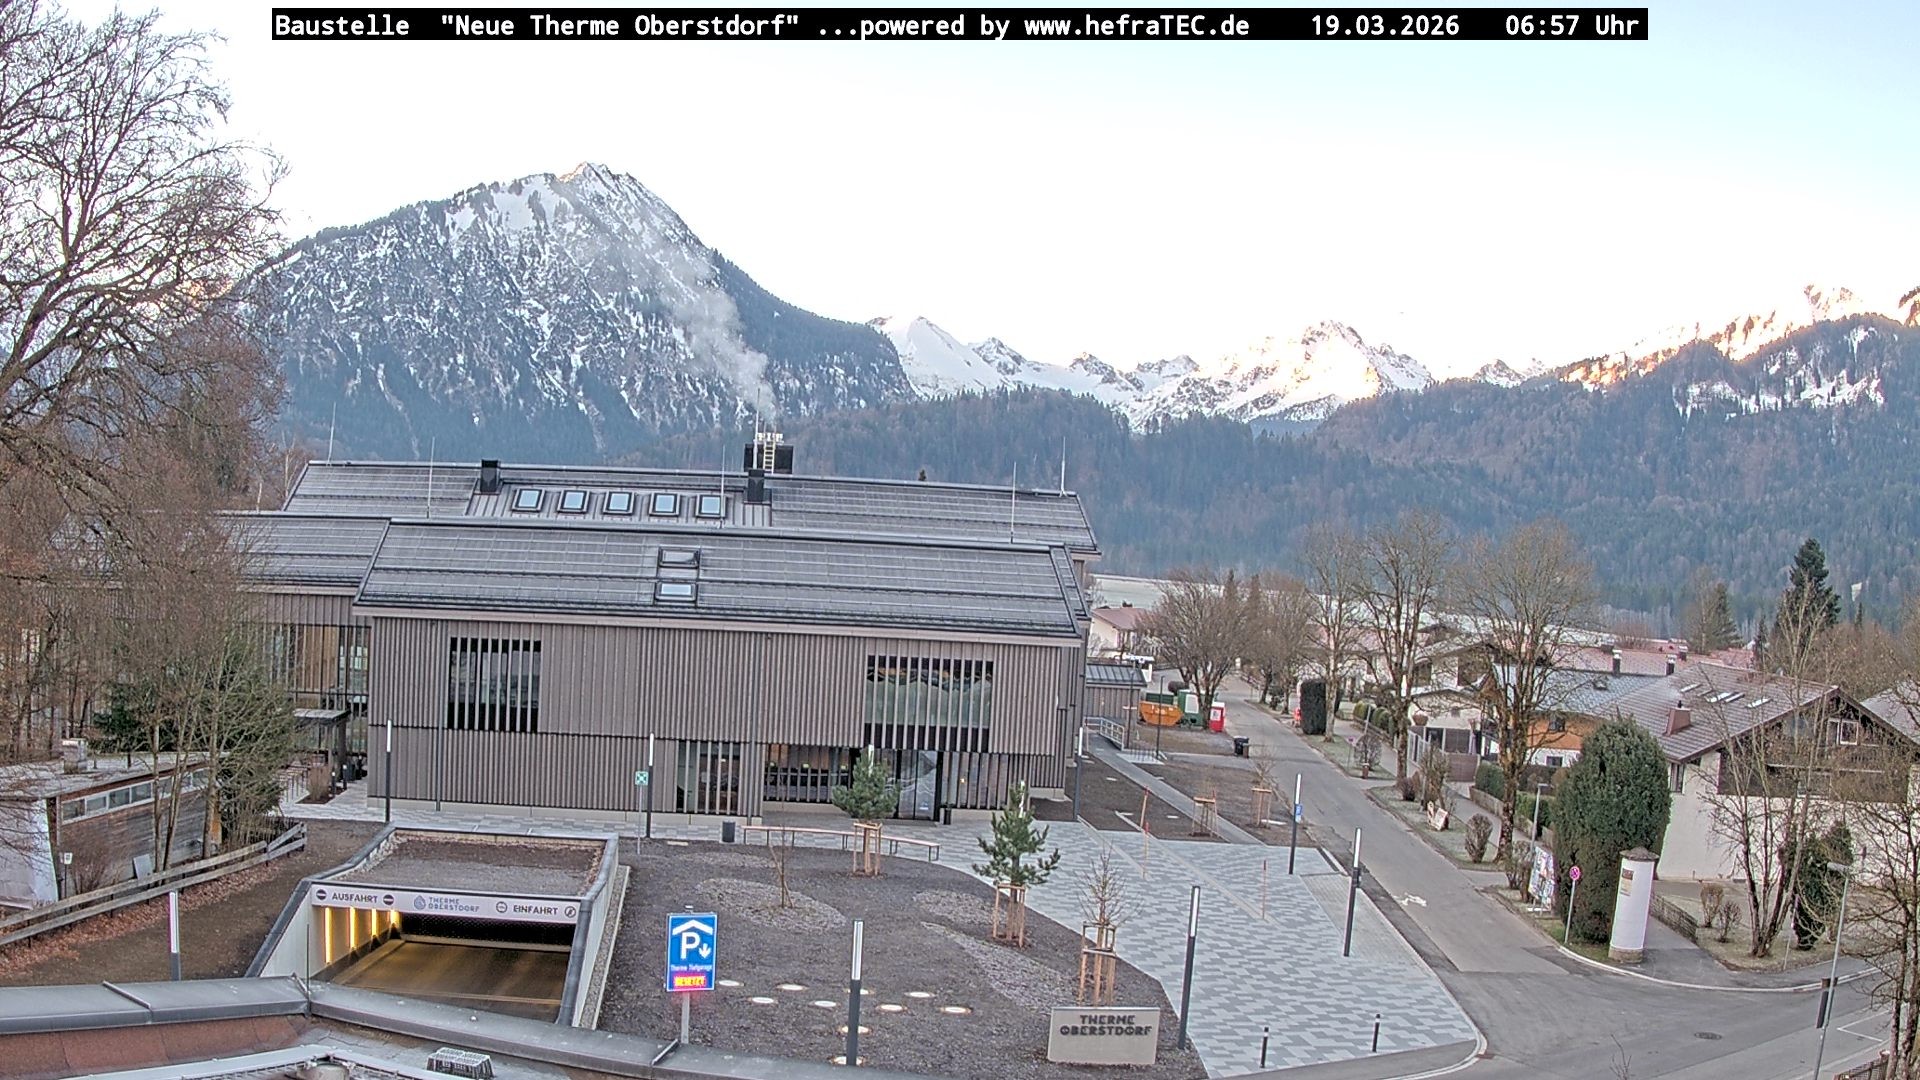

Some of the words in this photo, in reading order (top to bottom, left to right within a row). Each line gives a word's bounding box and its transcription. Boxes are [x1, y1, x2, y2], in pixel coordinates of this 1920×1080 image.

[331, 892, 378, 904] AUSFAHRT
[429, 896, 460, 905] THERME
[428, 903, 480, 913] OBERSTDORF
[512, 904, 559, 915] EINFAHRT
[680, 931, 701, 960] P
[1079, 1014, 1136, 1025] THERME
[1060, 1025, 1153, 1036] OBERSTDORF
